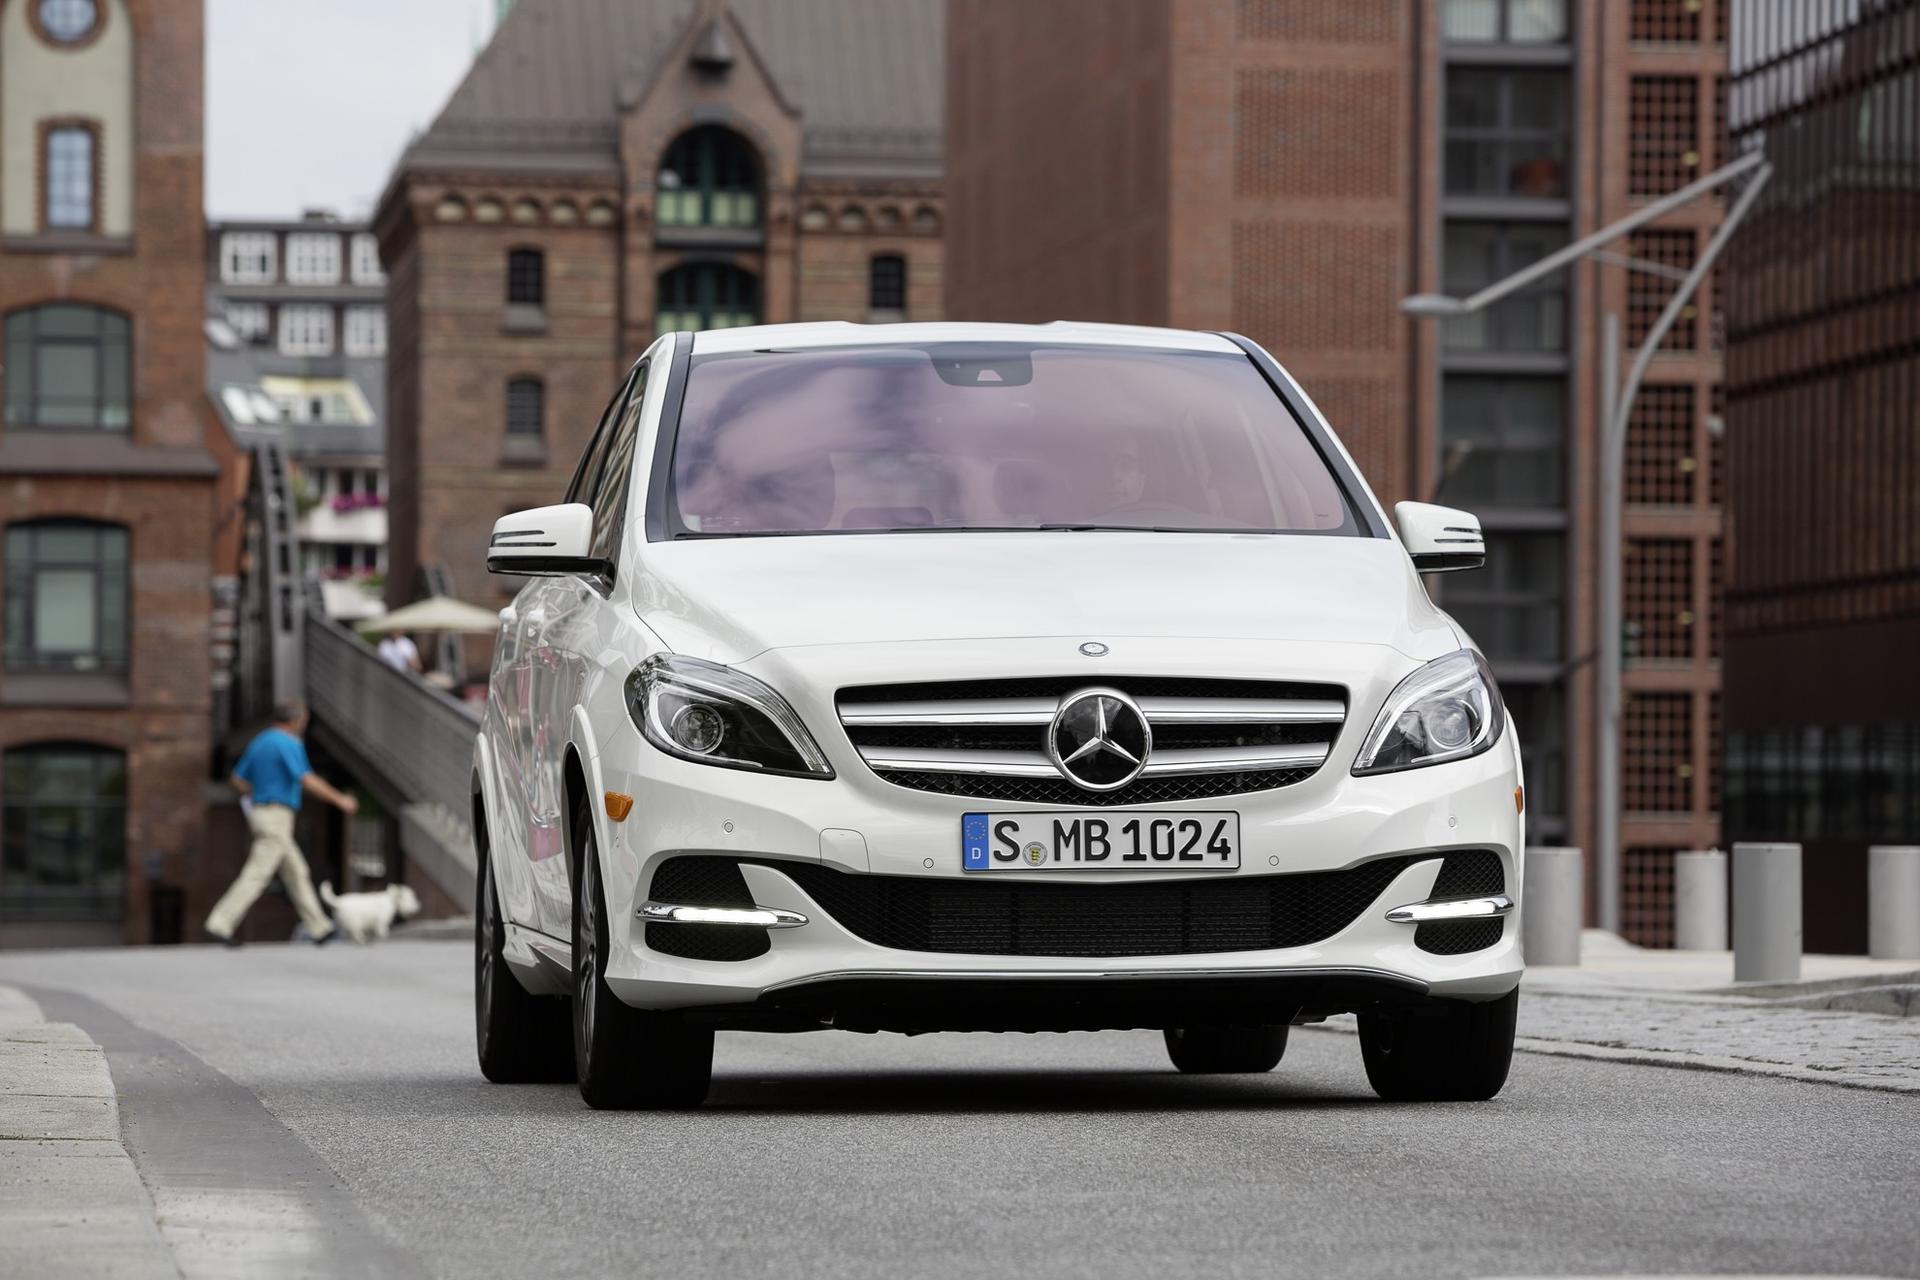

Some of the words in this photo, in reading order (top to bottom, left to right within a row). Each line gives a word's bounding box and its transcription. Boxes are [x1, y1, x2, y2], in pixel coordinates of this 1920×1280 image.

[971, 847, 981, 860] D
[994, 819, 1020, 862] S
[1053, 819, 1111, 862] MB
[1122, 819, 1231, 861] 1024
